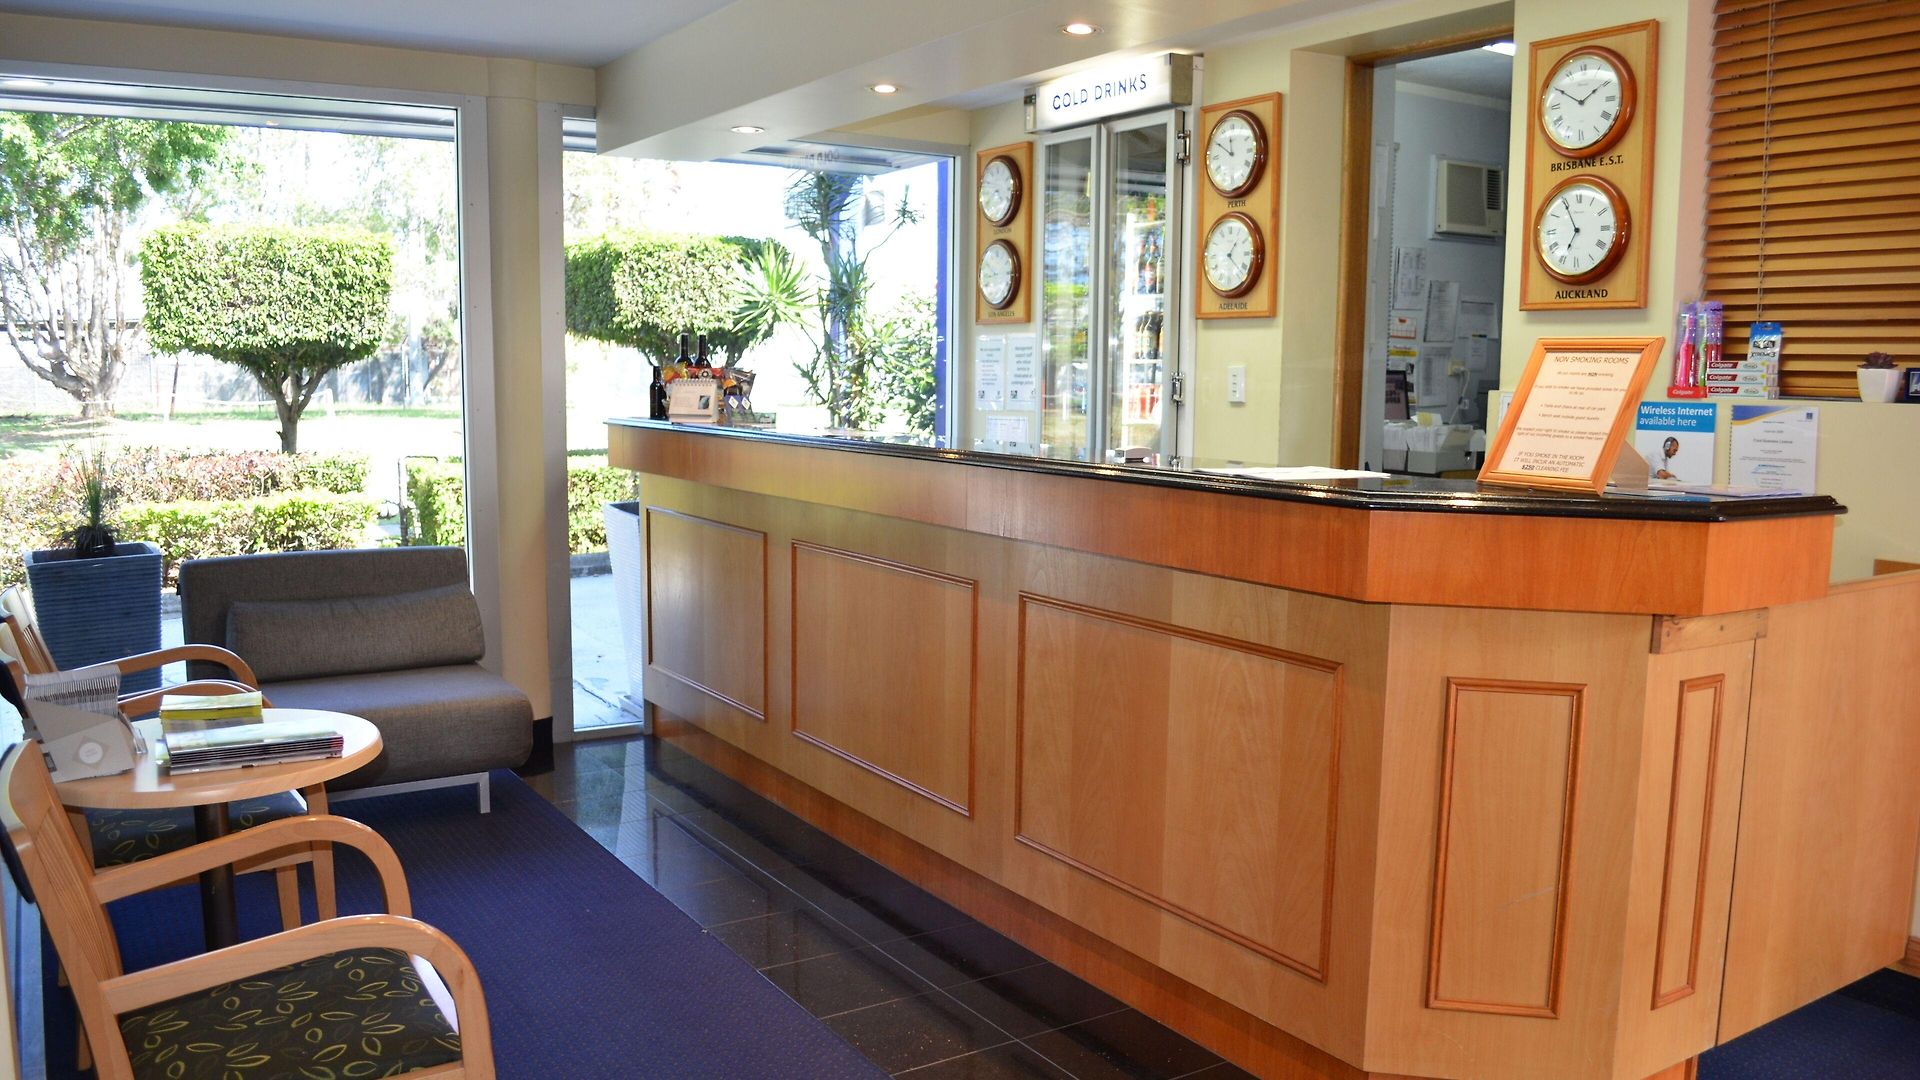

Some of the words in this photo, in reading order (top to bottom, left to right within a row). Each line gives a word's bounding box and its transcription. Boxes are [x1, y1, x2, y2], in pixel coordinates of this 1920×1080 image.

[1052, 88, 1088, 110] COLD
[1094, 73, 1147, 100] DRINKS
[1551, 157, 1597, 172] BRISBANE
[1600, 154, 1624, 166] E.S.T.
[1227, 200, 1246, 208] PERTH
[1554, 289, 1608, 299] AUCKLAND
[1219, 302, 1248, 310] ADELAIDE
[1570, 356, 1602, 364] SMOKING
[1603, 357, 1630, 365] ROOMS
[1710, 361, 1734, 369] Colgate
[1710, 386, 1734, 394] Colgate
[1640, 405, 1676, 415] Wireless
[1677, 406, 1713, 416] Internet
[1639, 416, 1675, 426] available
[1677, 417, 1697, 426] here
